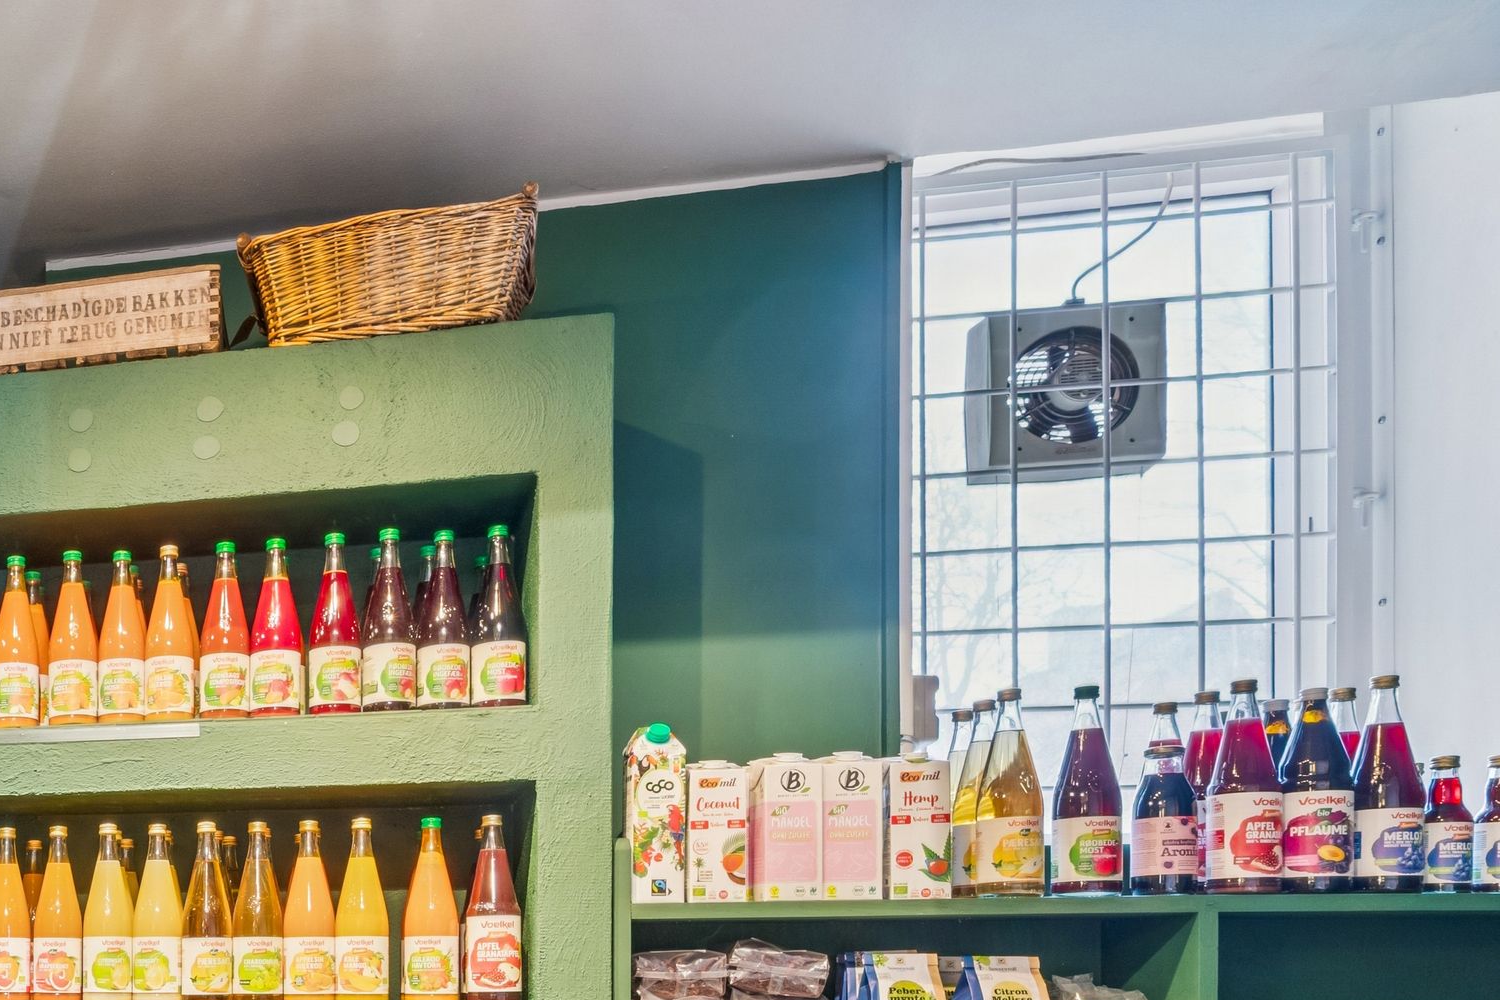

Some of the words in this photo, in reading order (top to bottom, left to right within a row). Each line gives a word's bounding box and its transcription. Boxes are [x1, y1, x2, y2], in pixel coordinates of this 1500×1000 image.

[0, 294, 126, 328] BESCHADIGDE
[133, 284, 212, 311] BAKKEN
[6, 327, 52, 350] NIET
[57, 319, 118, 345] TERUG
[124, 307, 211, 338] GENOMEN
[696, 796, 740, 812] Coconut
[904, 790, 939, 808] Hemp
[1298, 795, 1346, 806] Voelkel
[771, 816, 812, 828] MANDEL
[828, 815, 871, 827] MANDEL
[1084, 819, 1118, 828] Voelkel
[1246, 822, 1275, 832] APFEL
[1290, 825, 1348, 836] PFLAUME
[1384, 831, 1423, 841] MERLOT
[1079, 846, 1105, 855] MOST
[1161, 847, 1198, 858] Aroni
[480, 920, 515, 929] Voelkel
[477, 941, 500, 950] APFEL
[889, 986, 926, 995] Peber-
[994, 988, 1028, 996] Citron
